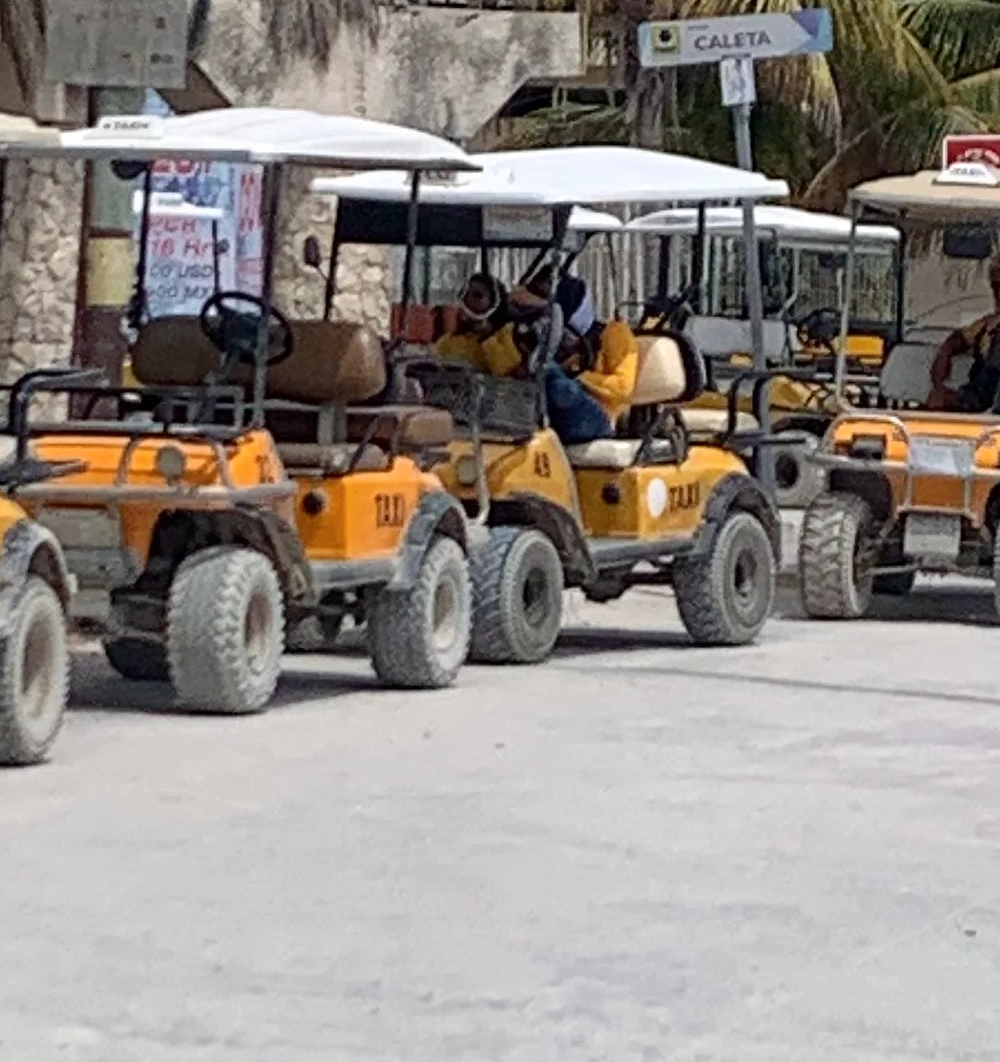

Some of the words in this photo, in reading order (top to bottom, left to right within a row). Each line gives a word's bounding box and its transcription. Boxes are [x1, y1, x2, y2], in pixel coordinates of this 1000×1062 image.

[694, 30, 771, 50] CALETA
[374, 493, 405, 527] TAXI
[669, 481, 700, 512] TAXI
